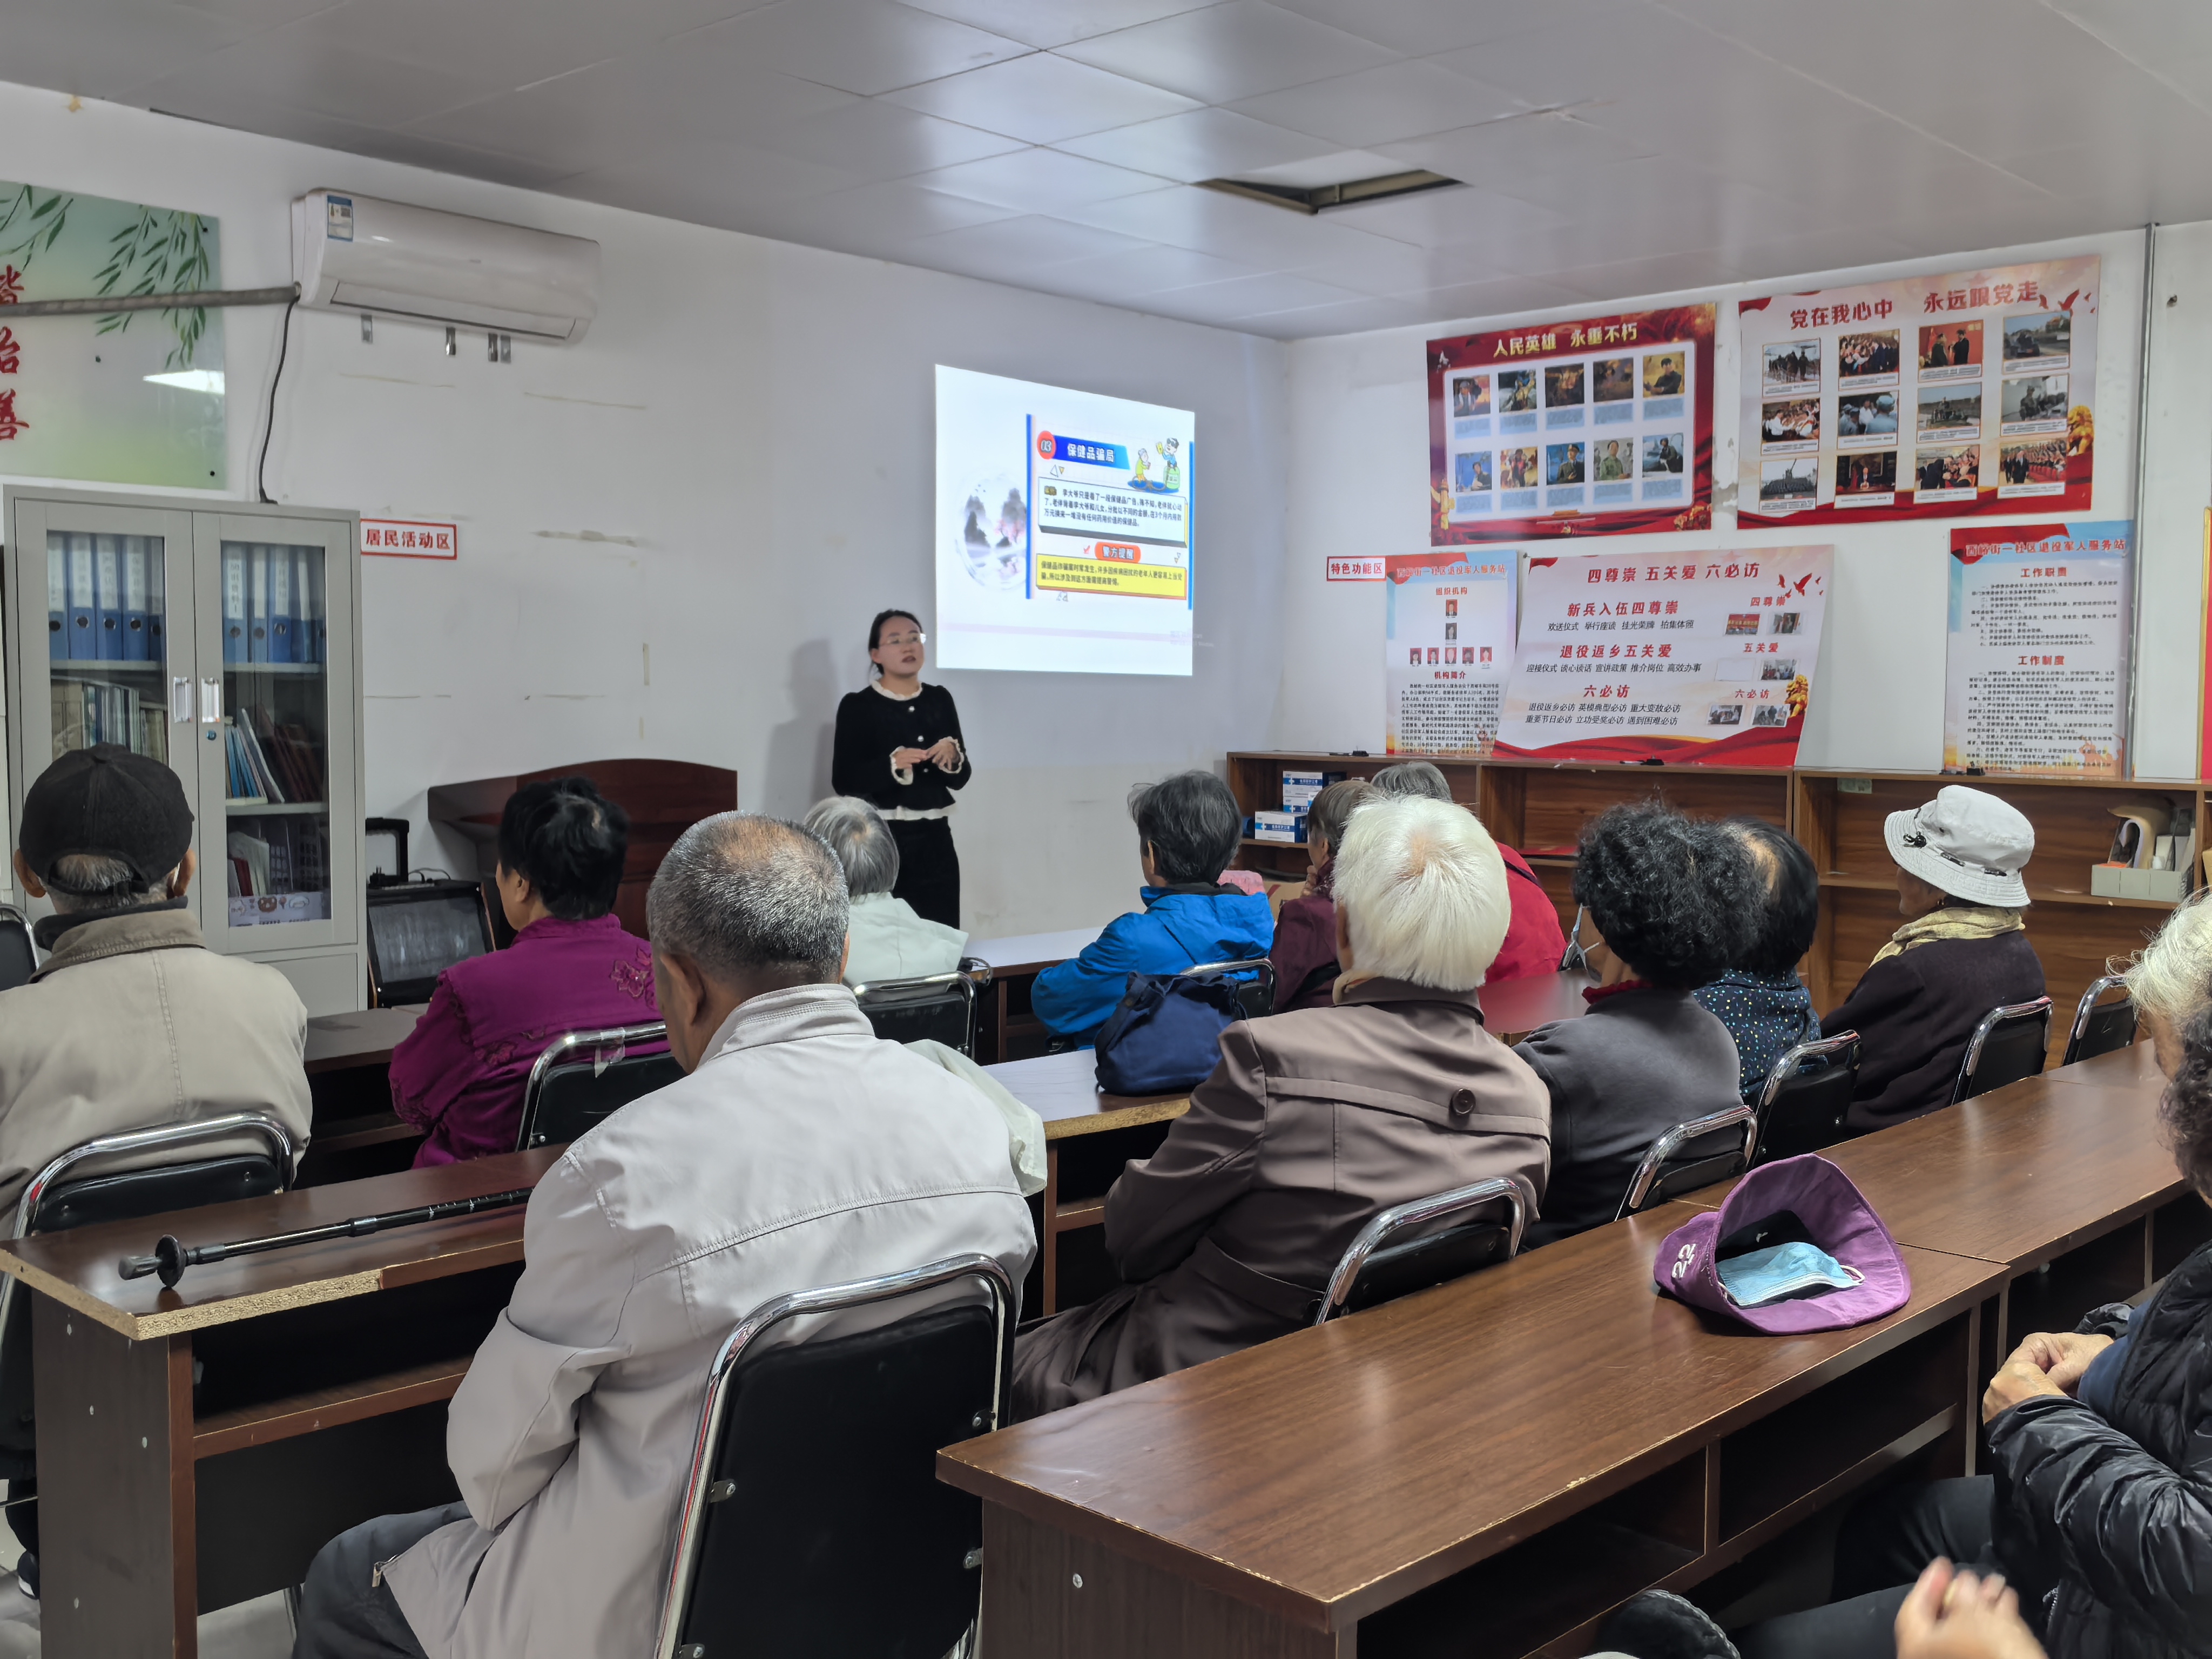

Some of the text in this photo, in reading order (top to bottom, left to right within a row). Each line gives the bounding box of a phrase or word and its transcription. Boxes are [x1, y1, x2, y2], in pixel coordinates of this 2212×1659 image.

[1790, 280, 2039, 330] 党在我心中 永远跟党走
[1493, 322, 1637, 358] 人民英雄 永垂不朽
[1040, 440, 1053, 453] 03
[1067, 442, 1115, 463] 保健品骗局
[366, 528, 450, 550] 居民活动区
[1102, 546, 1134, 560] 警方提醒
[1331, 562, 1382, 575] 特色功能区
[1588, 563, 1760, 583] 四尊崇 五关爱 六必访
[2020, 567, 2067, 578] 工作职责
[1435, 586, 1468, 595] 组织机构
[1750, 596, 1786, 607] 四尊崇
[1567, 600, 1679, 617] 新兵入伍四尊崇
[1547, 619, 1695, 631] 欢送仪式 举行座谈 挂光荣牌 拍集体照
[1560, 644, 1673, 659] 退役返乡五关爱
[1743, 642, 1779, 653] 五关爱
[2018, 655, 2065, 666] 工作制度
[1526, 663, 1702, 673] 迎接仪式 谈心谈话 宣讲政策 推介岗位 高效办事
[1434, 671, 1466, 680] 机构简介
[1583, 684, 1630, 698] 六必访
[1735, 689, 1770, 699] 六必访
[1528, 703, 1681, 713] 退役返乡必访 英模典型必访 重大变故必访
[1525, 714, 1678, 725] 重要节日必访 立功受奖必访 遇到困难必访
